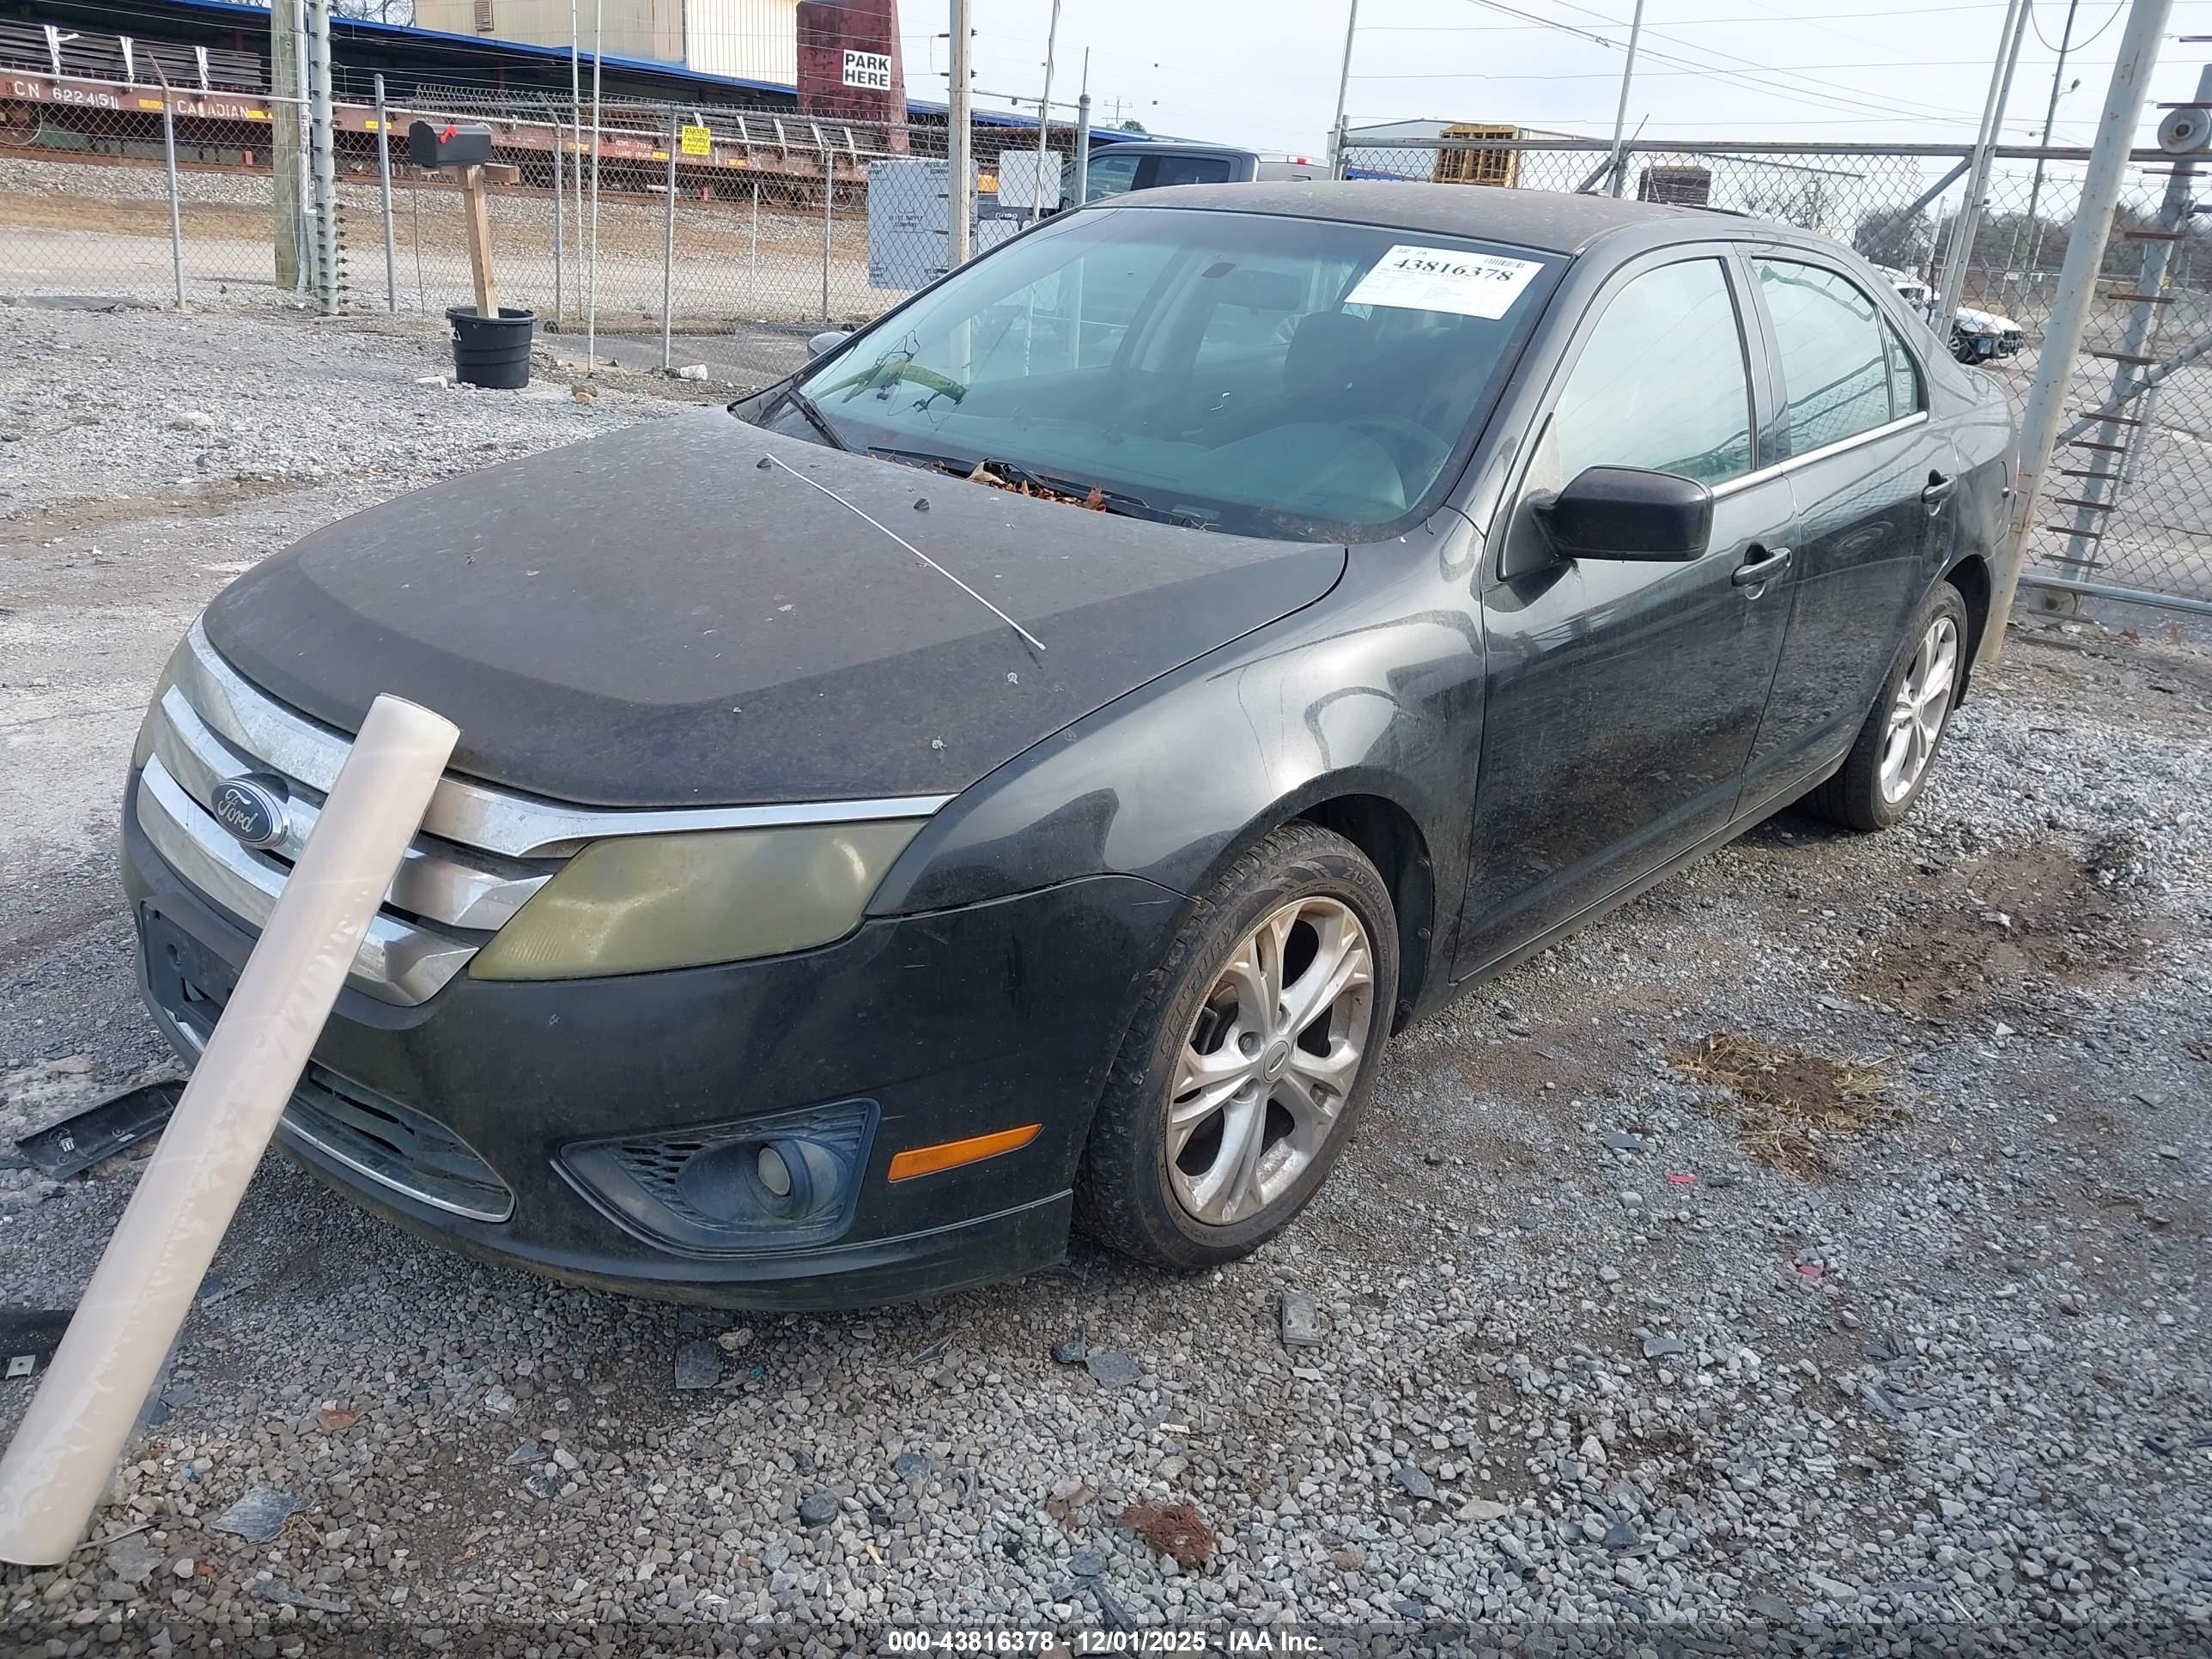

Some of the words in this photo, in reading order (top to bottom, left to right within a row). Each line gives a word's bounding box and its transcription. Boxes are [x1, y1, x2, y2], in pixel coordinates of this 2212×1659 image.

[846, 52, 890, 72] PARK
[844, 69, 889, 88] HERE
[14, 81, 40, 98] CN
[177, 100, 250, 119] CAADIAN
[1393, 258, 1514, 282] 43816378
[217, 788, 258, 833] Ford
